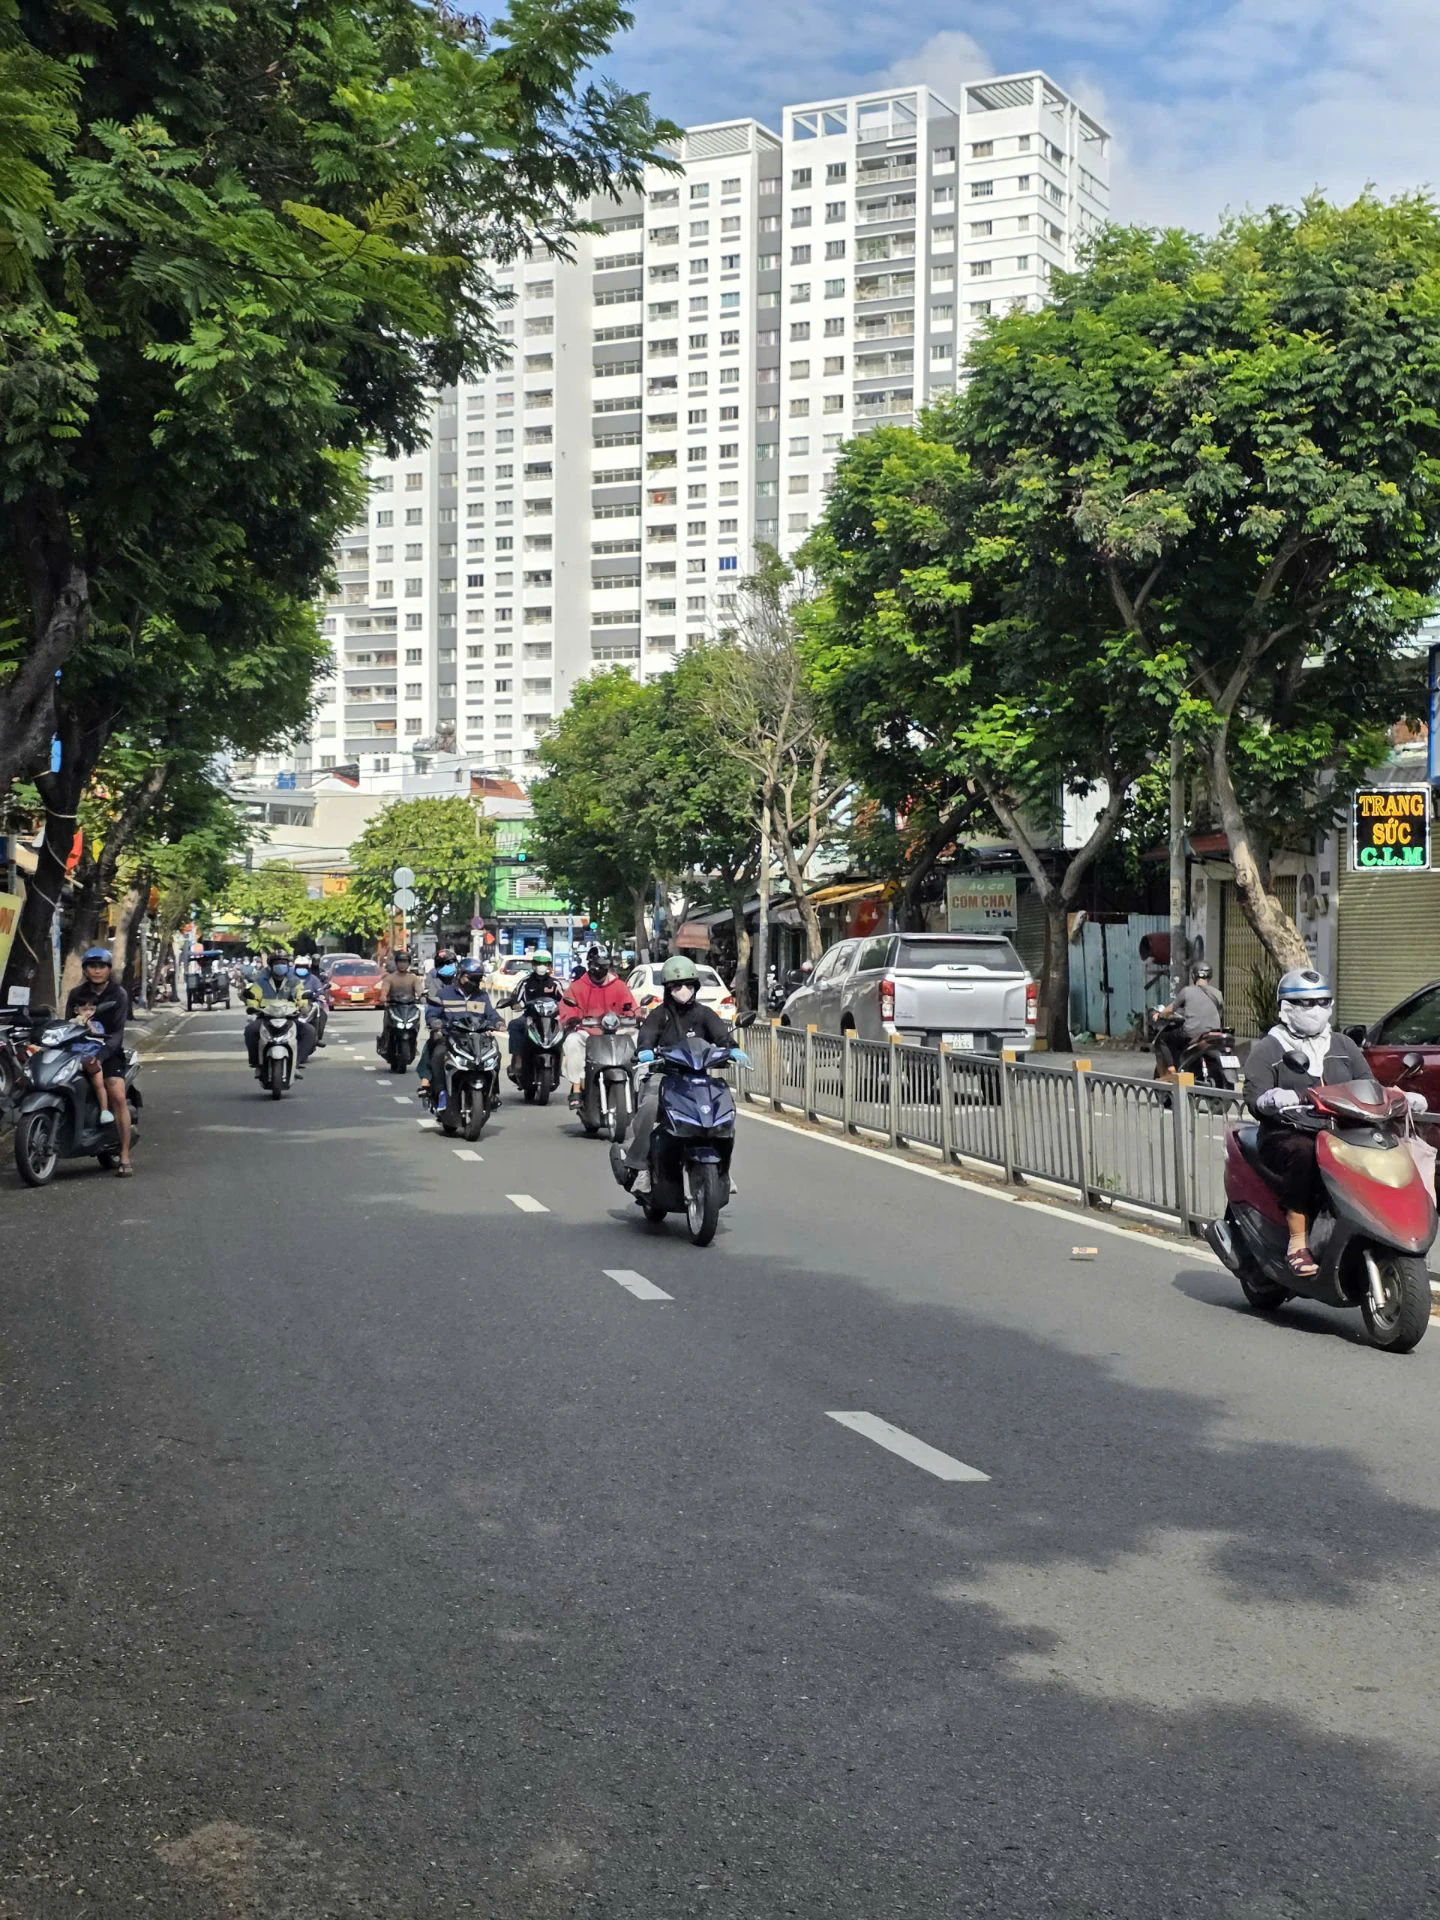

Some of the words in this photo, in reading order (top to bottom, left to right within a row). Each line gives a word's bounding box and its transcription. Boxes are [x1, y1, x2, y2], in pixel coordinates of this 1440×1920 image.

[1359, 795, 1424, 816] TRANG
[1373, 817, 1412, 845] SỨC
[1360, 847, 1424, 867] C.L.M
[982, 894, 1013, 908] CHAY
